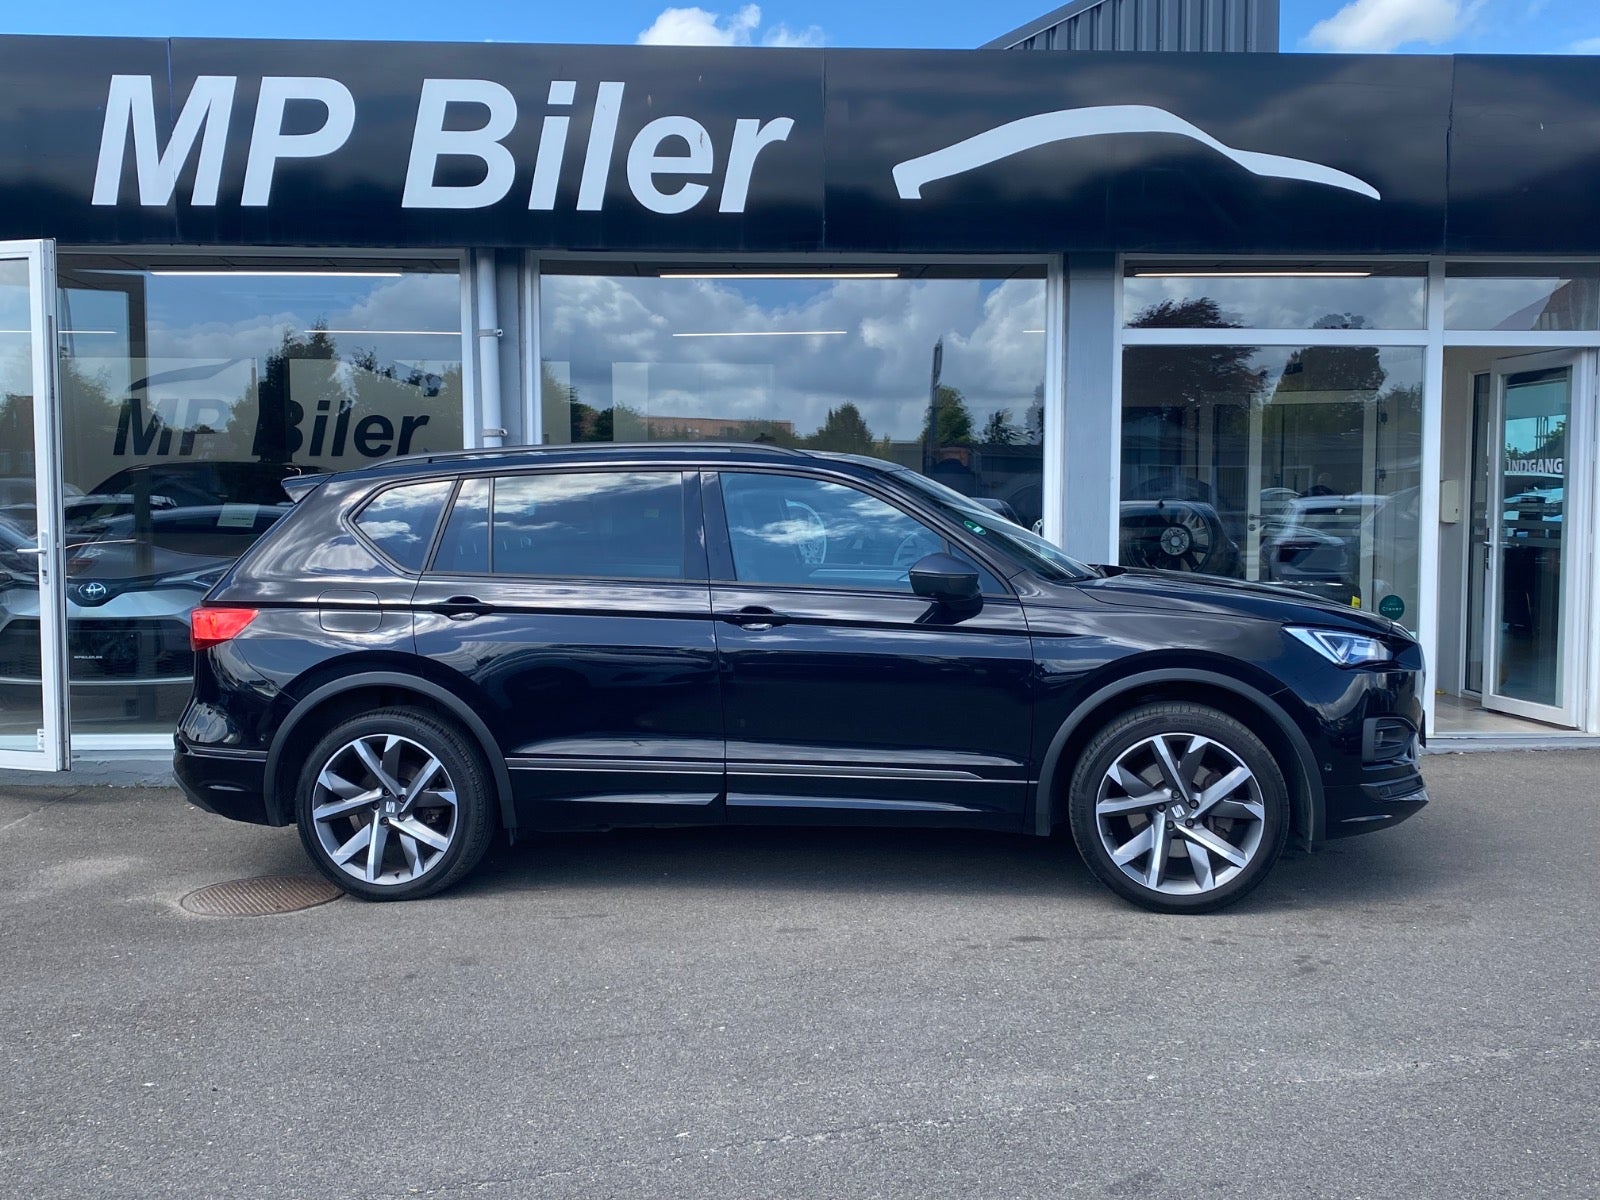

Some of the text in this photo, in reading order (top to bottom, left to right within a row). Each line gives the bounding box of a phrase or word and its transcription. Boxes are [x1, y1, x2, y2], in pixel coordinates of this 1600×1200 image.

[92, 74, 795, 215] MP Biler
[113, 398, 430, 458] MP Biler
[1507, 458, 1564, 473] INDGANG
